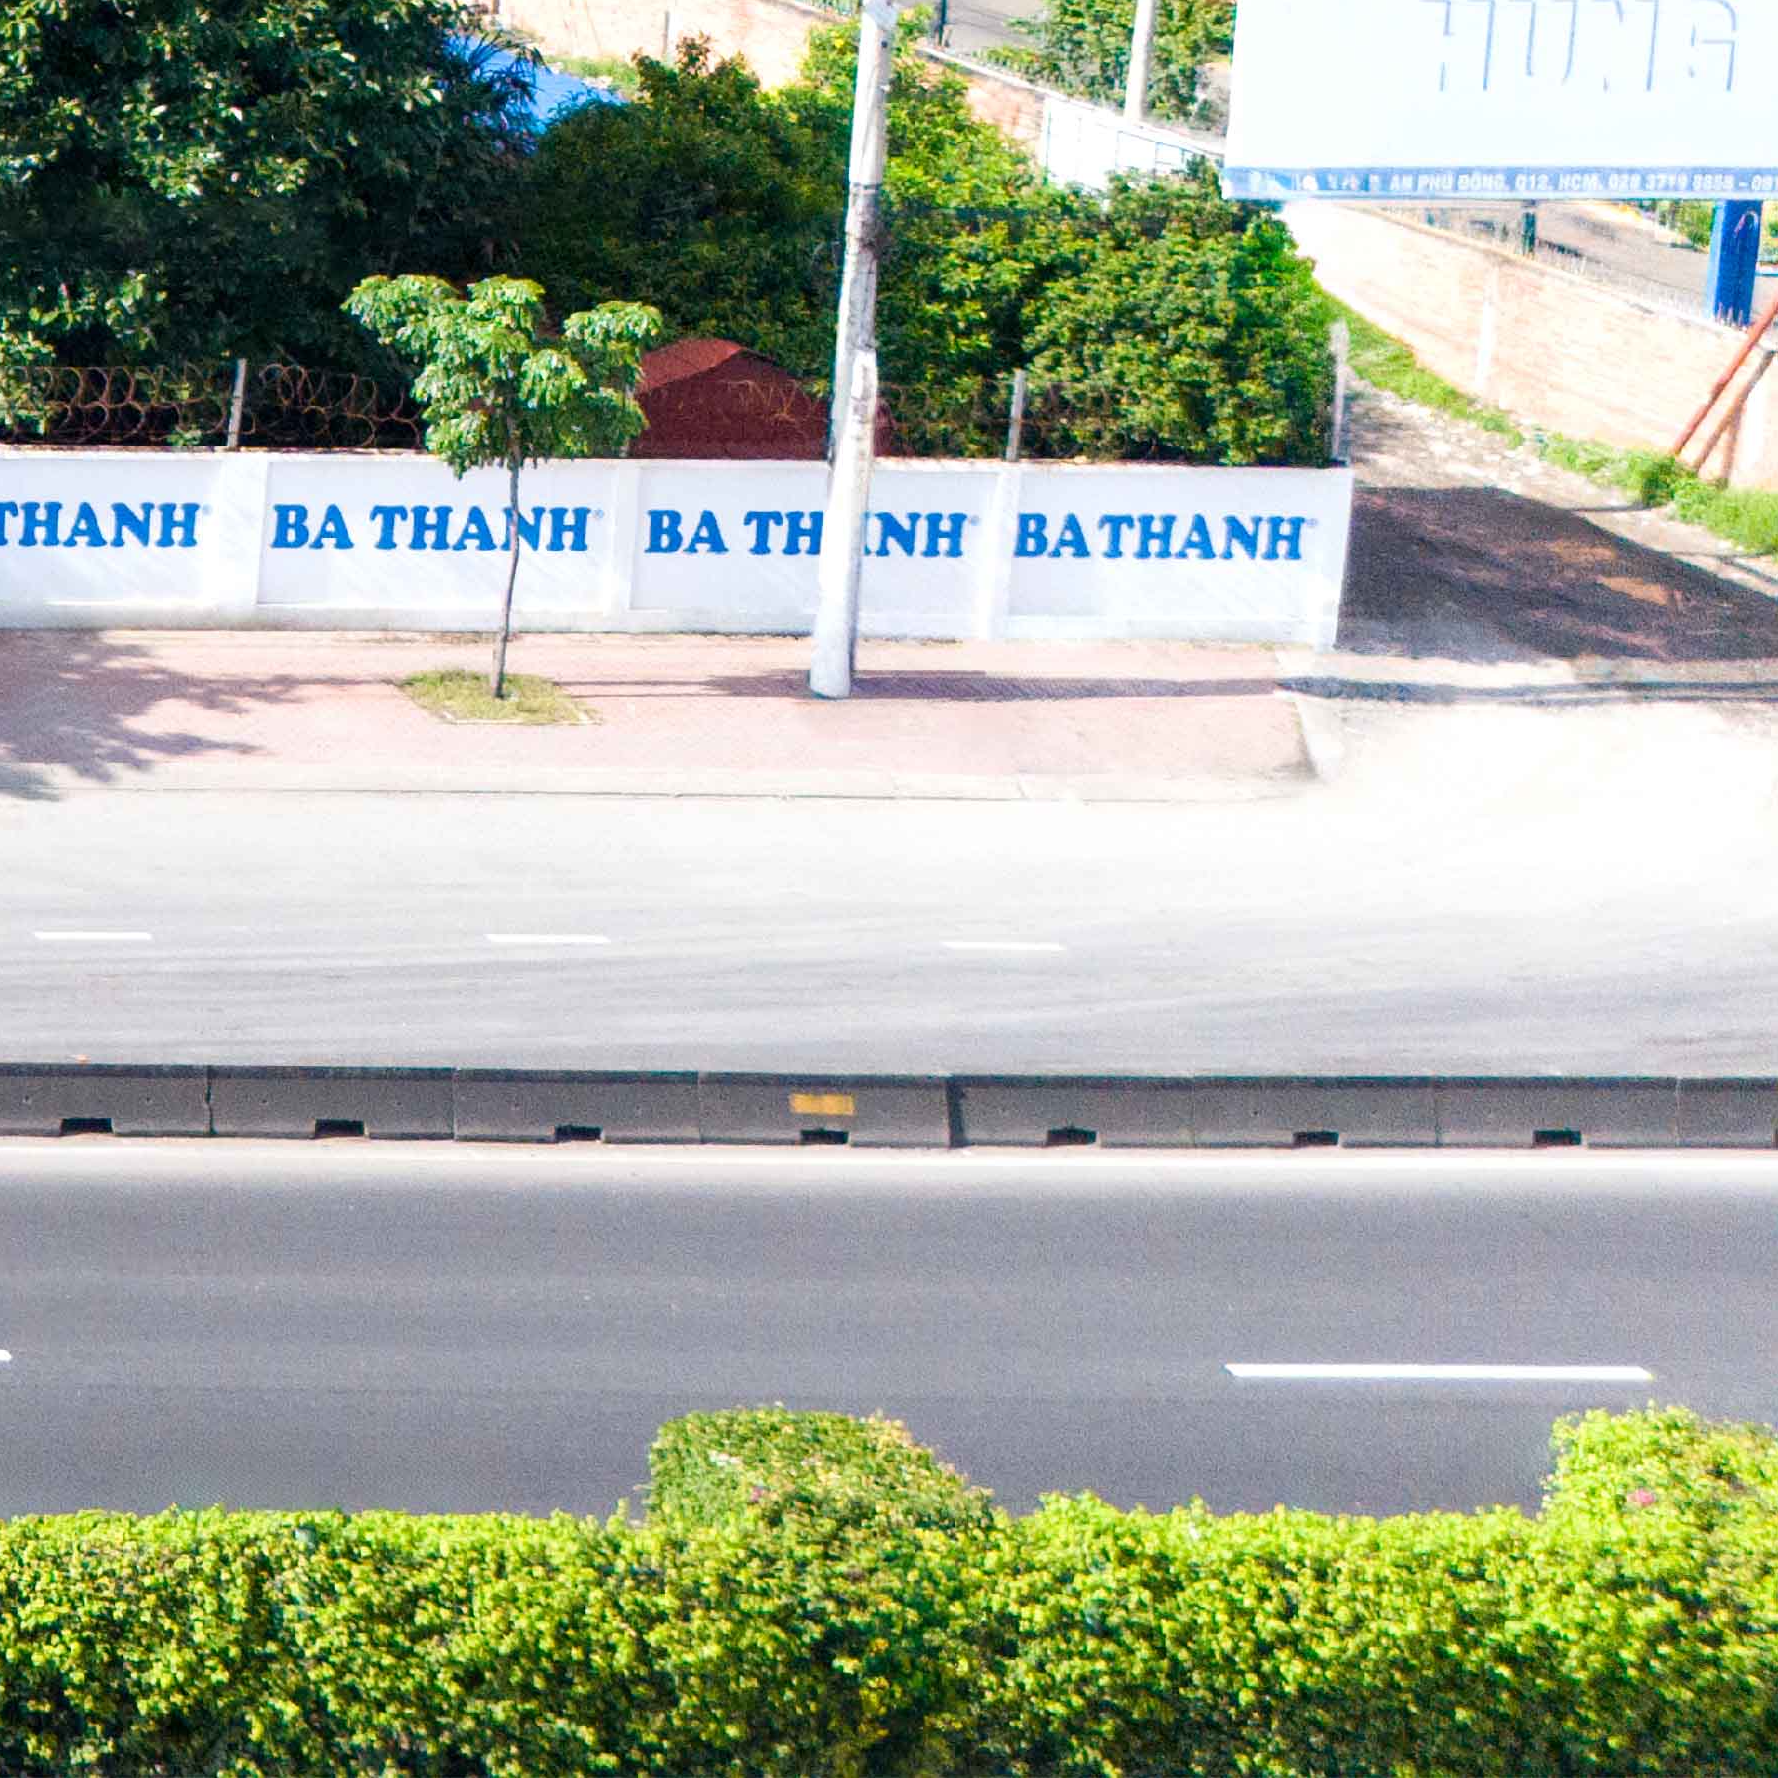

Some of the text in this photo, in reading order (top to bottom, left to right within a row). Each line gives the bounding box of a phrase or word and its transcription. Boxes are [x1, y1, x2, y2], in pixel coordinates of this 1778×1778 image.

[269, 503, 354, 550] BA
[644, 509, 968, 558] BA THNH
[1013, 512, 1090, 558] BA
